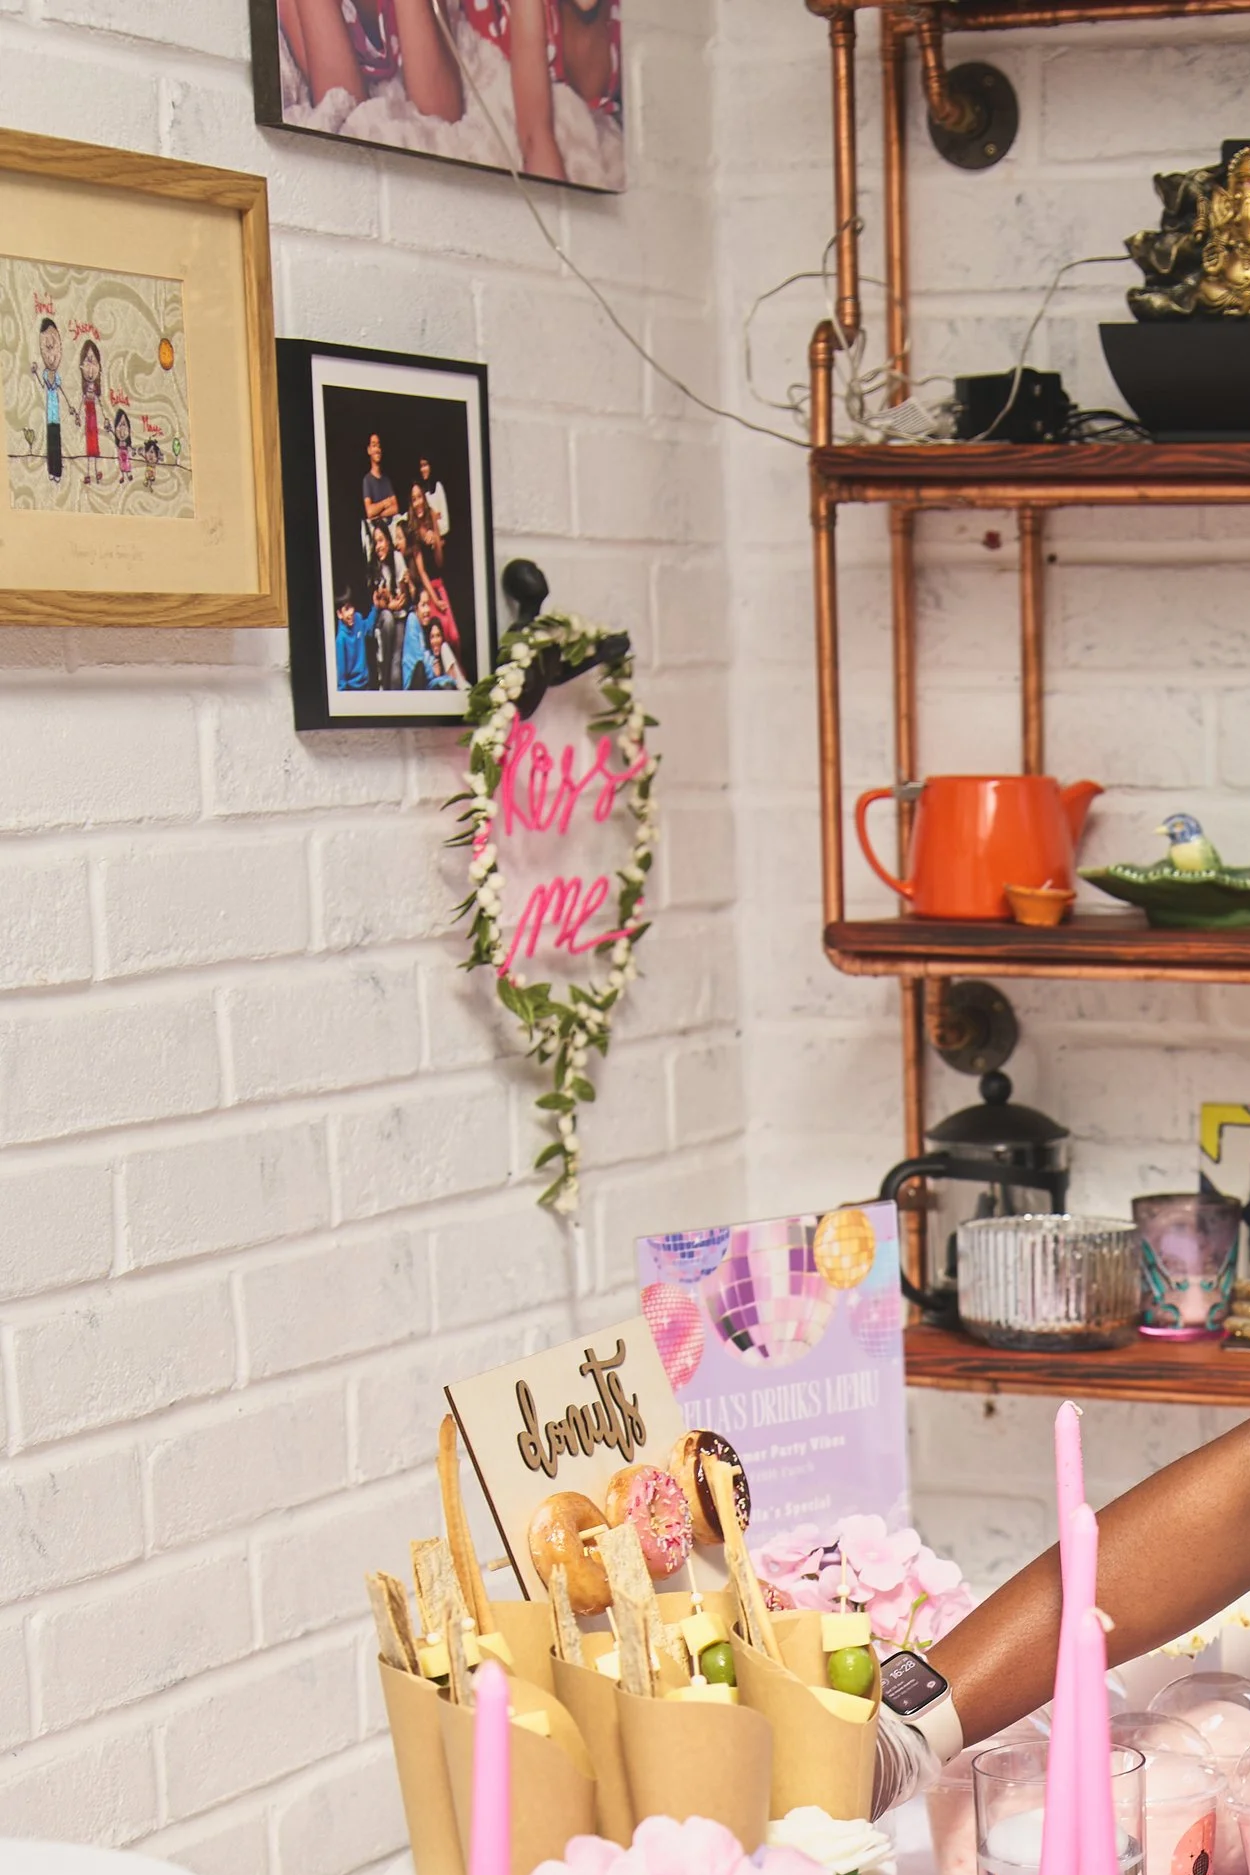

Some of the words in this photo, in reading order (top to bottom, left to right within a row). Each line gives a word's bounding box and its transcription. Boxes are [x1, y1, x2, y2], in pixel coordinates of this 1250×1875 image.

[515, 1339, 648, 1479] donuts
[683, 1392, 748, 1434] ELLA'S
[752, 1380, 822, 1428] DRINKS
[826, 1370, 880, 1414] MENU
[771, 1439, 807, 1460] Party
[810, 1435, 846, 1451] Vibes
[889, 1660, 916, 1679] 16:28
